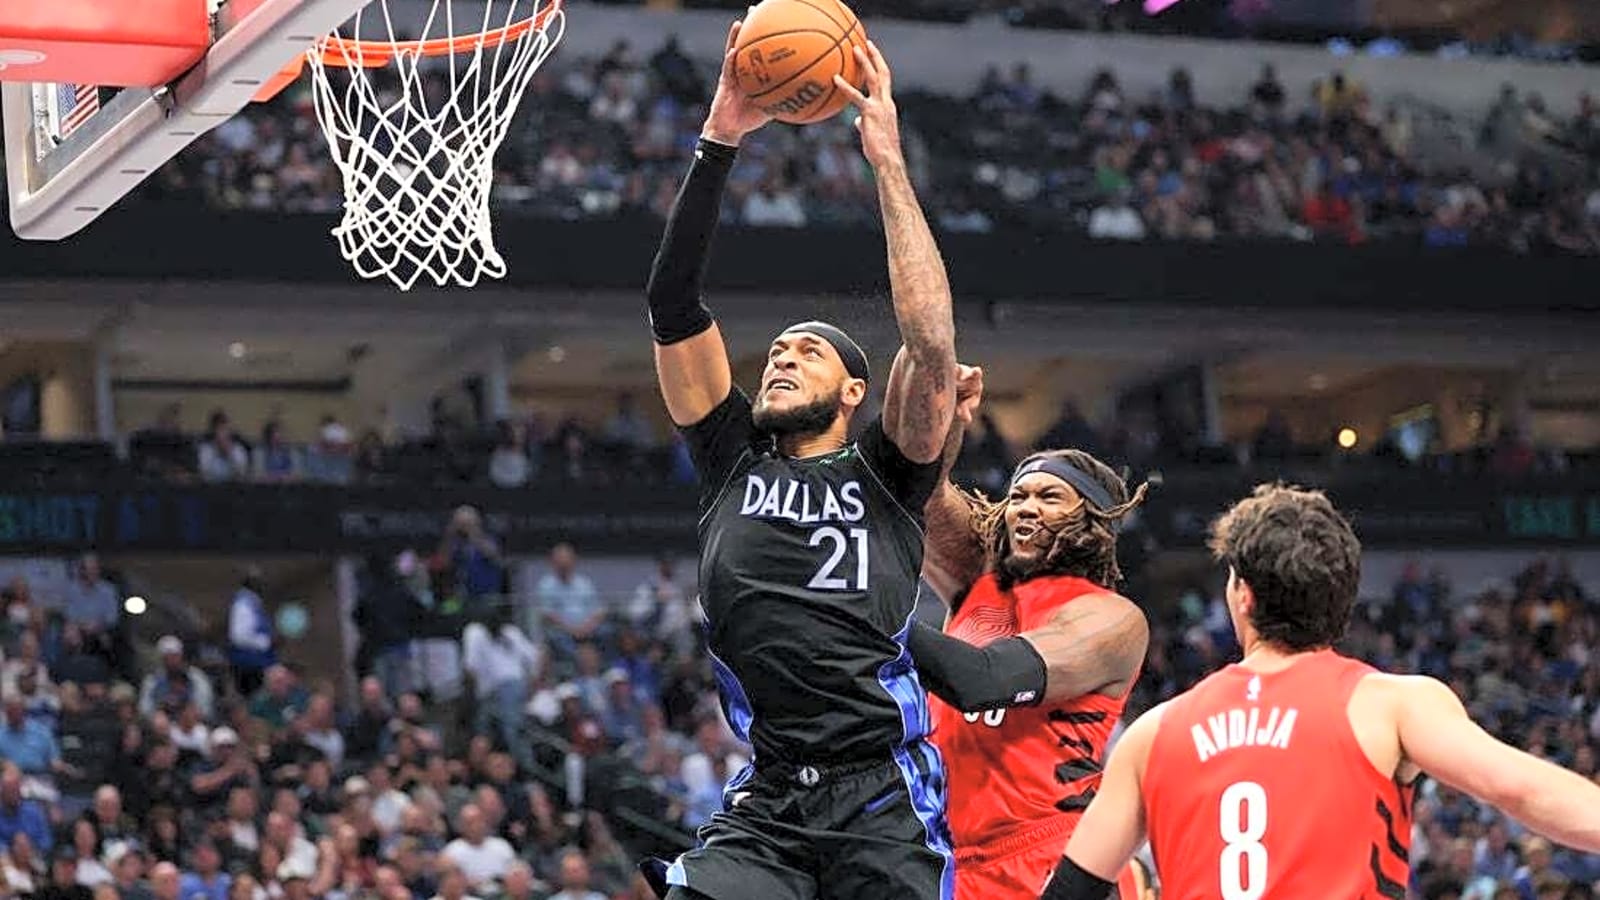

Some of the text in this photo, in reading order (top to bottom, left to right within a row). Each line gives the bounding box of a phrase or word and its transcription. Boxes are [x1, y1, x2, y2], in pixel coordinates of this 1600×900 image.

[740, 475, 866, 523] DALLAS
[807, 527, 868, 590] 21
[1191, 707, 1298, 762] AVDIJA
[1219, 781, 1269, 900] 8
